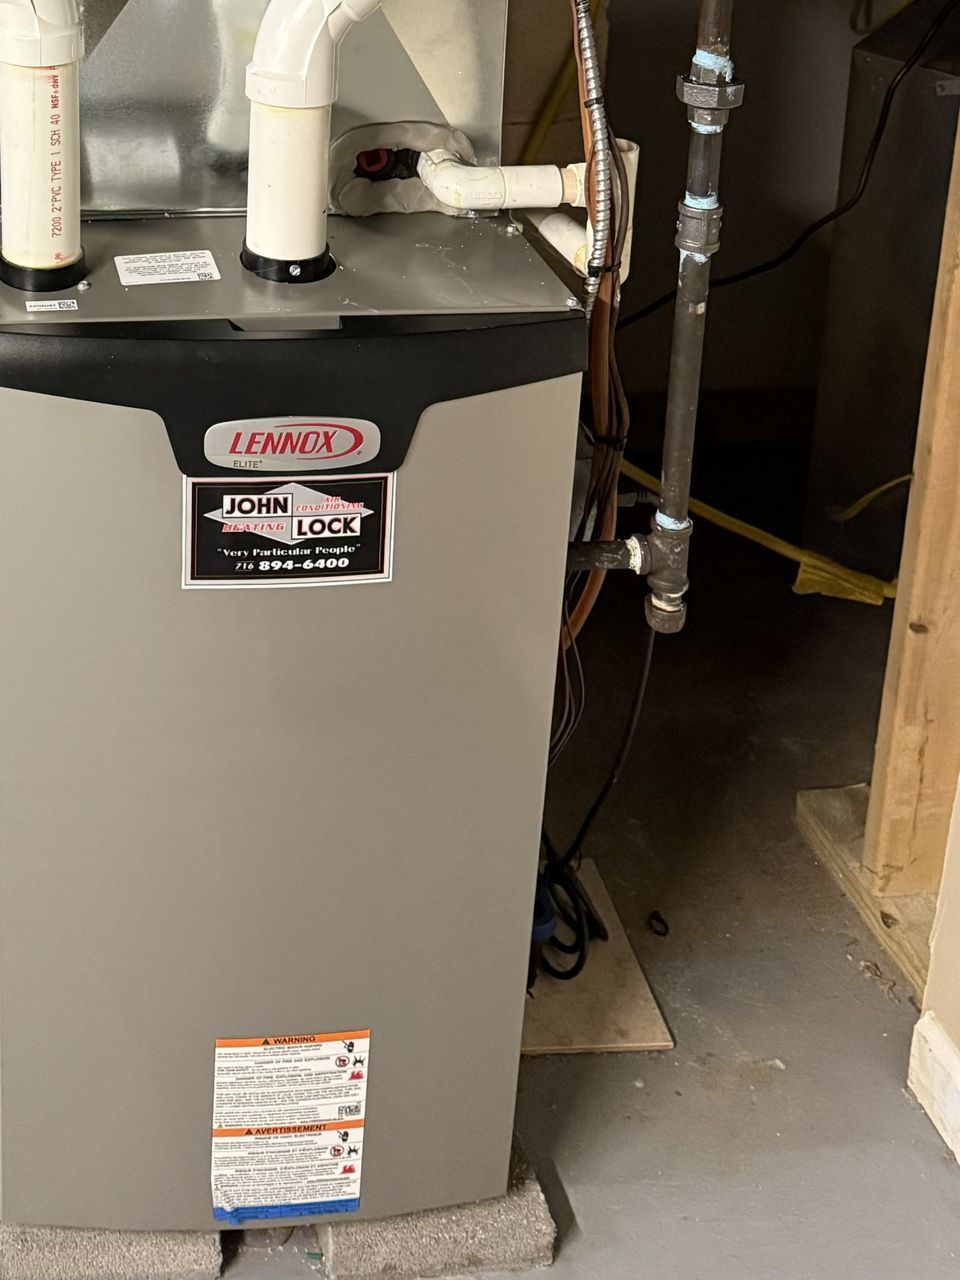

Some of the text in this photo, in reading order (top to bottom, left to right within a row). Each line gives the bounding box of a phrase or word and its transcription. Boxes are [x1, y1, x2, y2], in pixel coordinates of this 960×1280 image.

[50, 114, 61, 125] 40
[50, 129, 61, 147] SCH
[51, 160, 62, 182] TYPE
[51, 216, 62, 238] 7200
[229, 430, 338, 454] LENNOX
[225, 497, 289, 515] JOHN
[296, 502, 364, 512] CONDITIONING
[222, 522, 285, 532] HEATING
[297, 517, 357, 537] LOCK
[217, 544, 361, 558] "Very Particular People"
[235, 558, 349, 571] 716 894-6400
[273, 1036, 316, 1044] WARNING
[255, 1124, 327, 1135] AVERTISSEMENT
